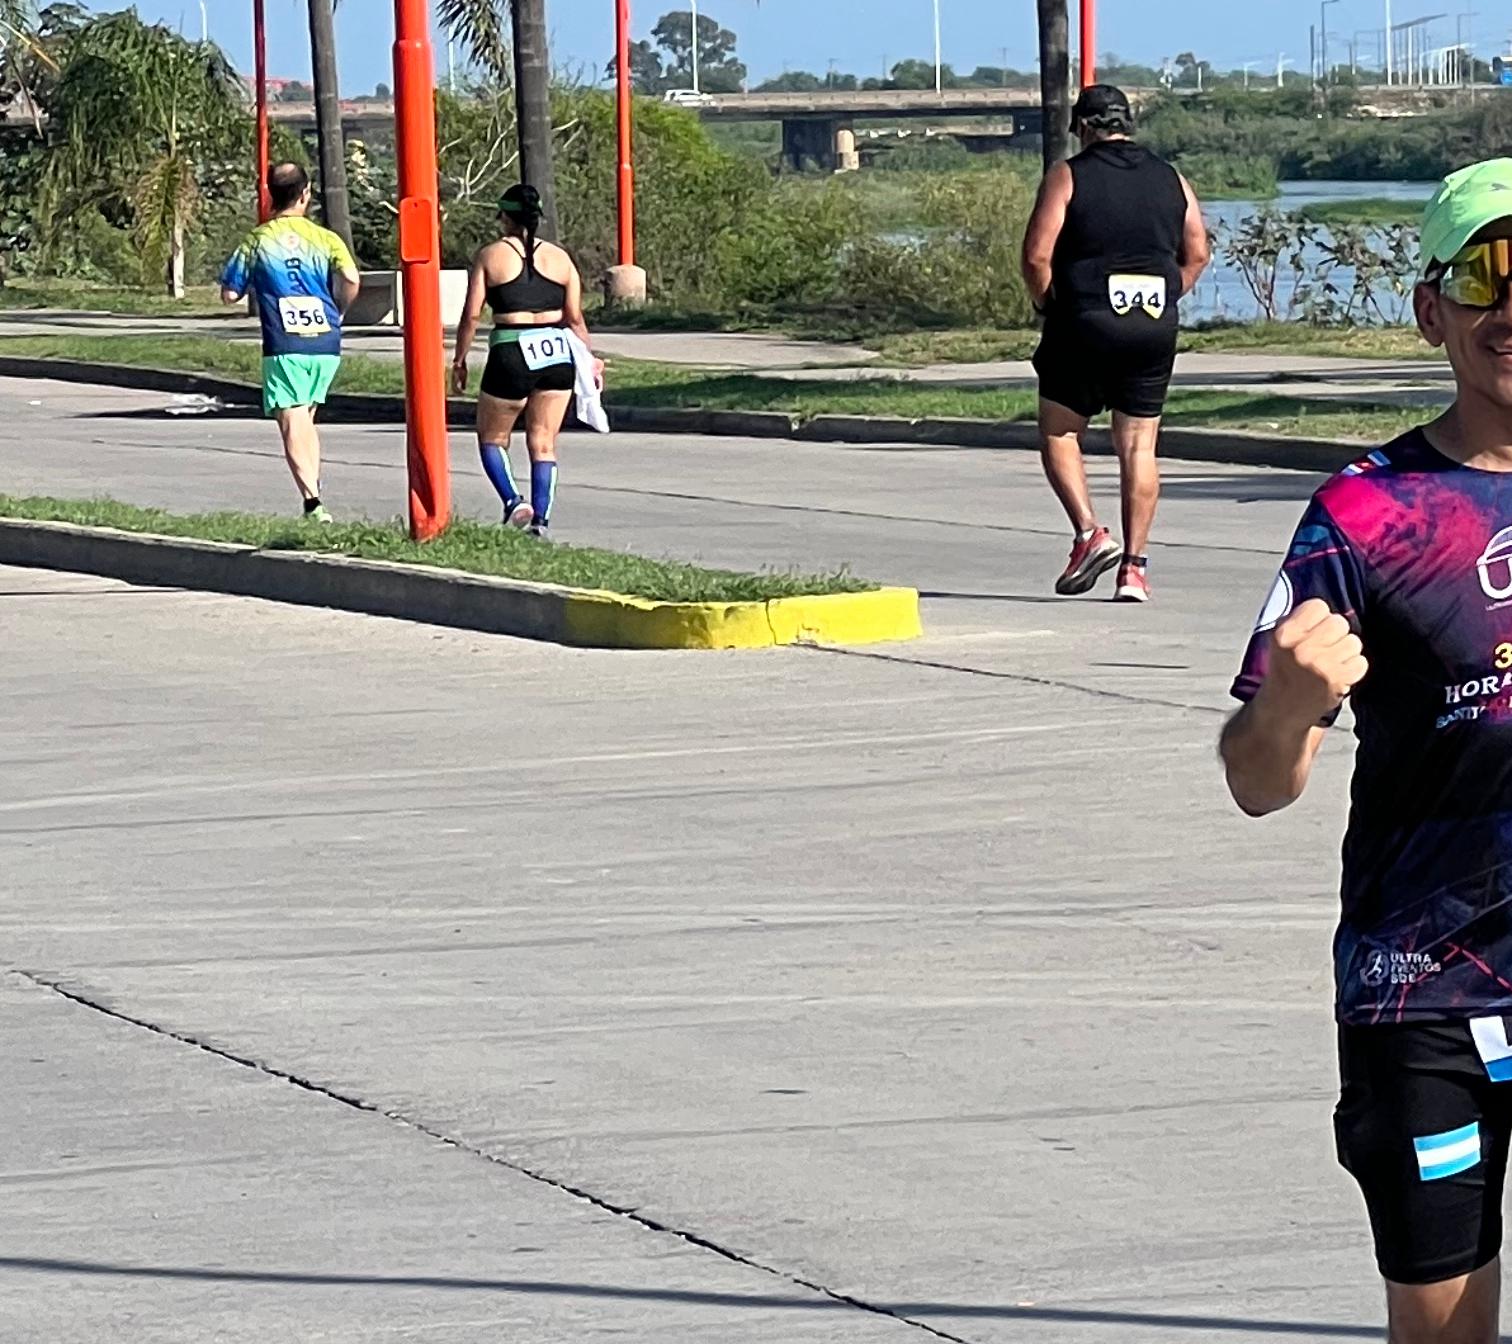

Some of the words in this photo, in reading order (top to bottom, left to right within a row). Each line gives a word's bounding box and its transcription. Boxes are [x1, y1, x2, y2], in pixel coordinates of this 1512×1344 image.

[1113, 290, 1161, 309] 344
[286, 309, 324, 326] 356
[527, 337, 565, 359] 107
[1390, 952, 1432, 963] ULTRA
